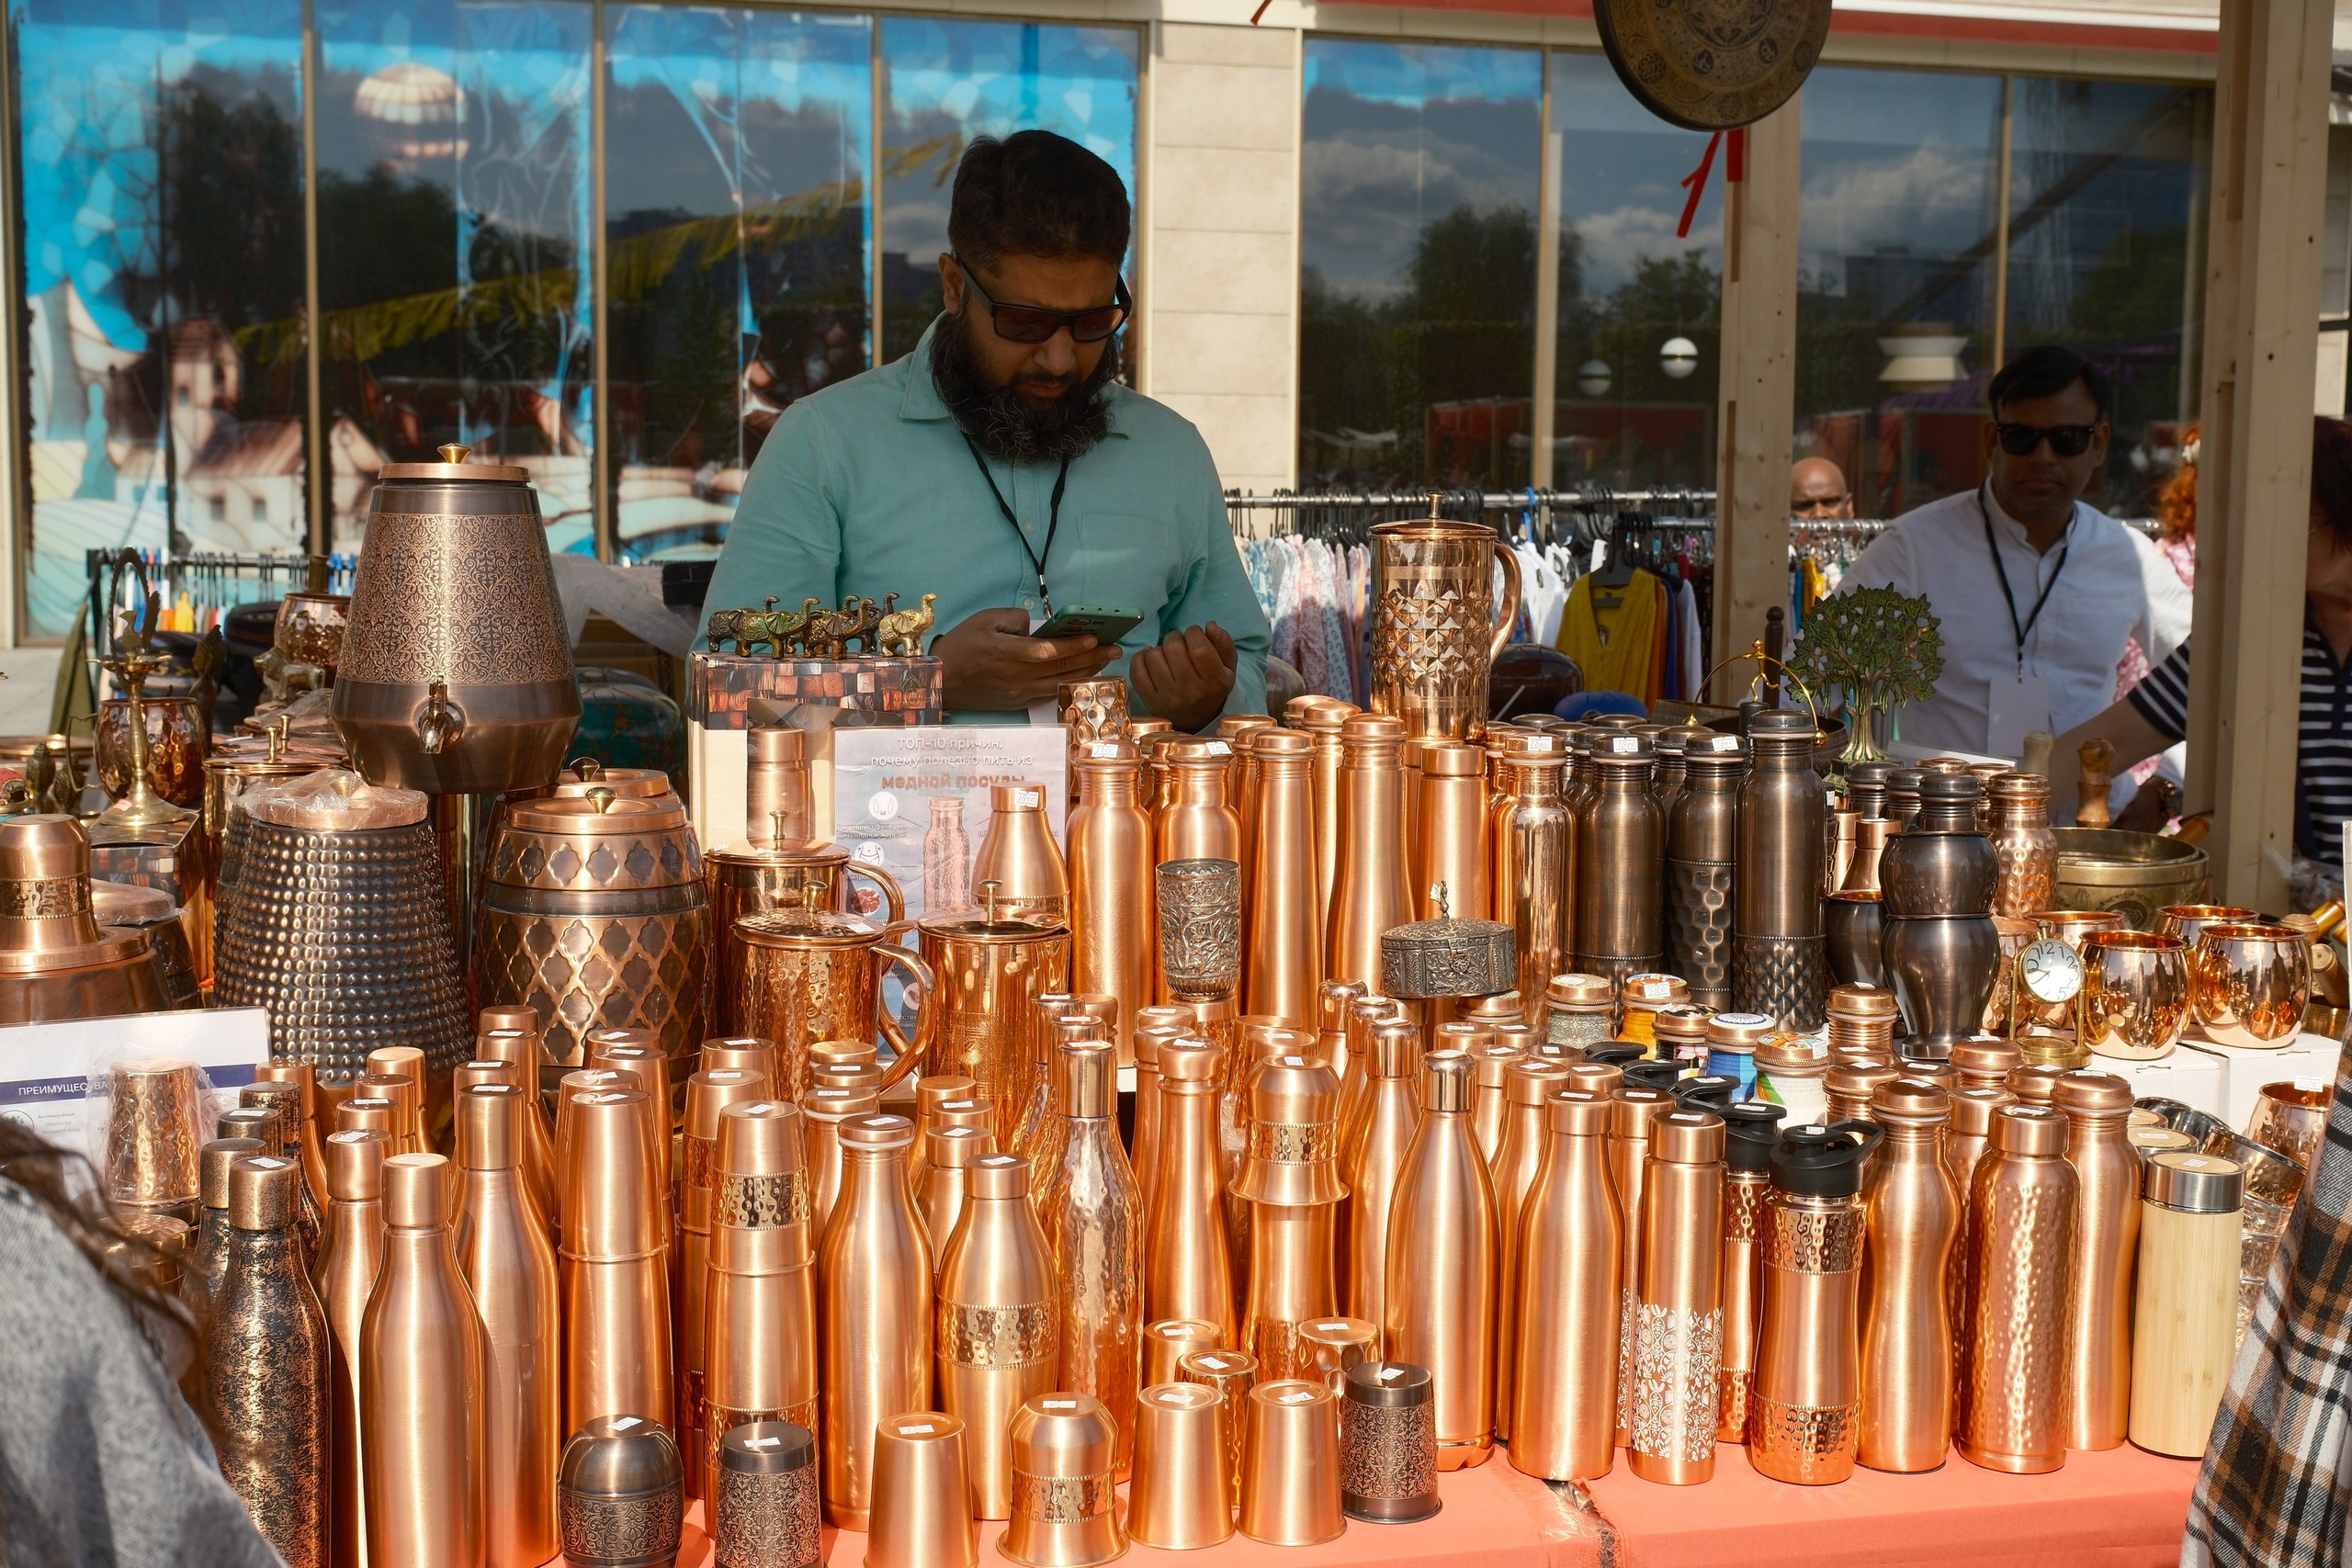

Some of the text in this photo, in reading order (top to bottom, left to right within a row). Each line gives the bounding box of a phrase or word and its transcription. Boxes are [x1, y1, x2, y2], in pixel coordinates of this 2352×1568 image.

[898, 738, 1003, 751] ТОП-10 причин,
[870, 754, 1033, 768] почему полезно пить из
[881, 773, 952, 790] медной
[17, 1081, 108, 1096] ПРЕИМУЩЕСВА
